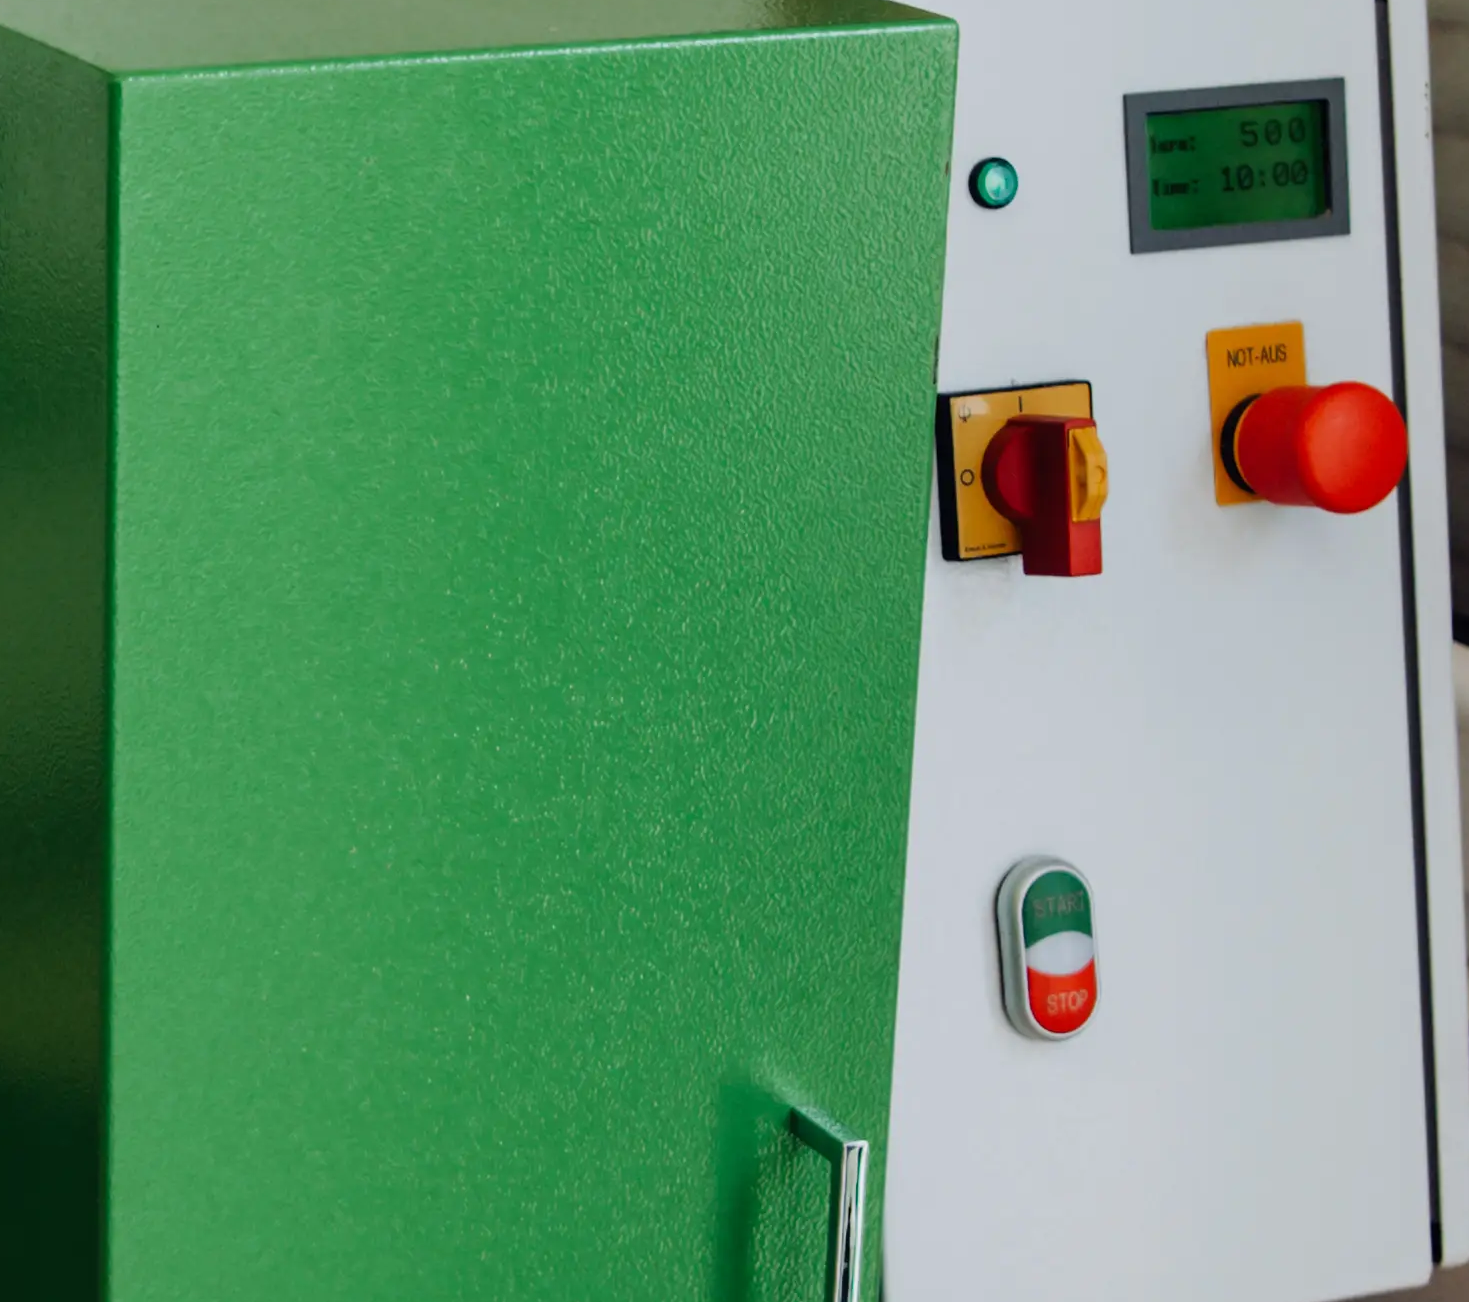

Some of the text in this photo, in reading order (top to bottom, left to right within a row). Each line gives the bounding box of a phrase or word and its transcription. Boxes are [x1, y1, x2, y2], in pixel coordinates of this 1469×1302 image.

[1239, 116, 1307, 148] 500
[1221, 159, 1310, 192] 10:00
[1226, 342, 1288, 369] NOT-AUS
[1032, 890, 1085, 920] START
[1046, 988, 1090, 1017] STOP
